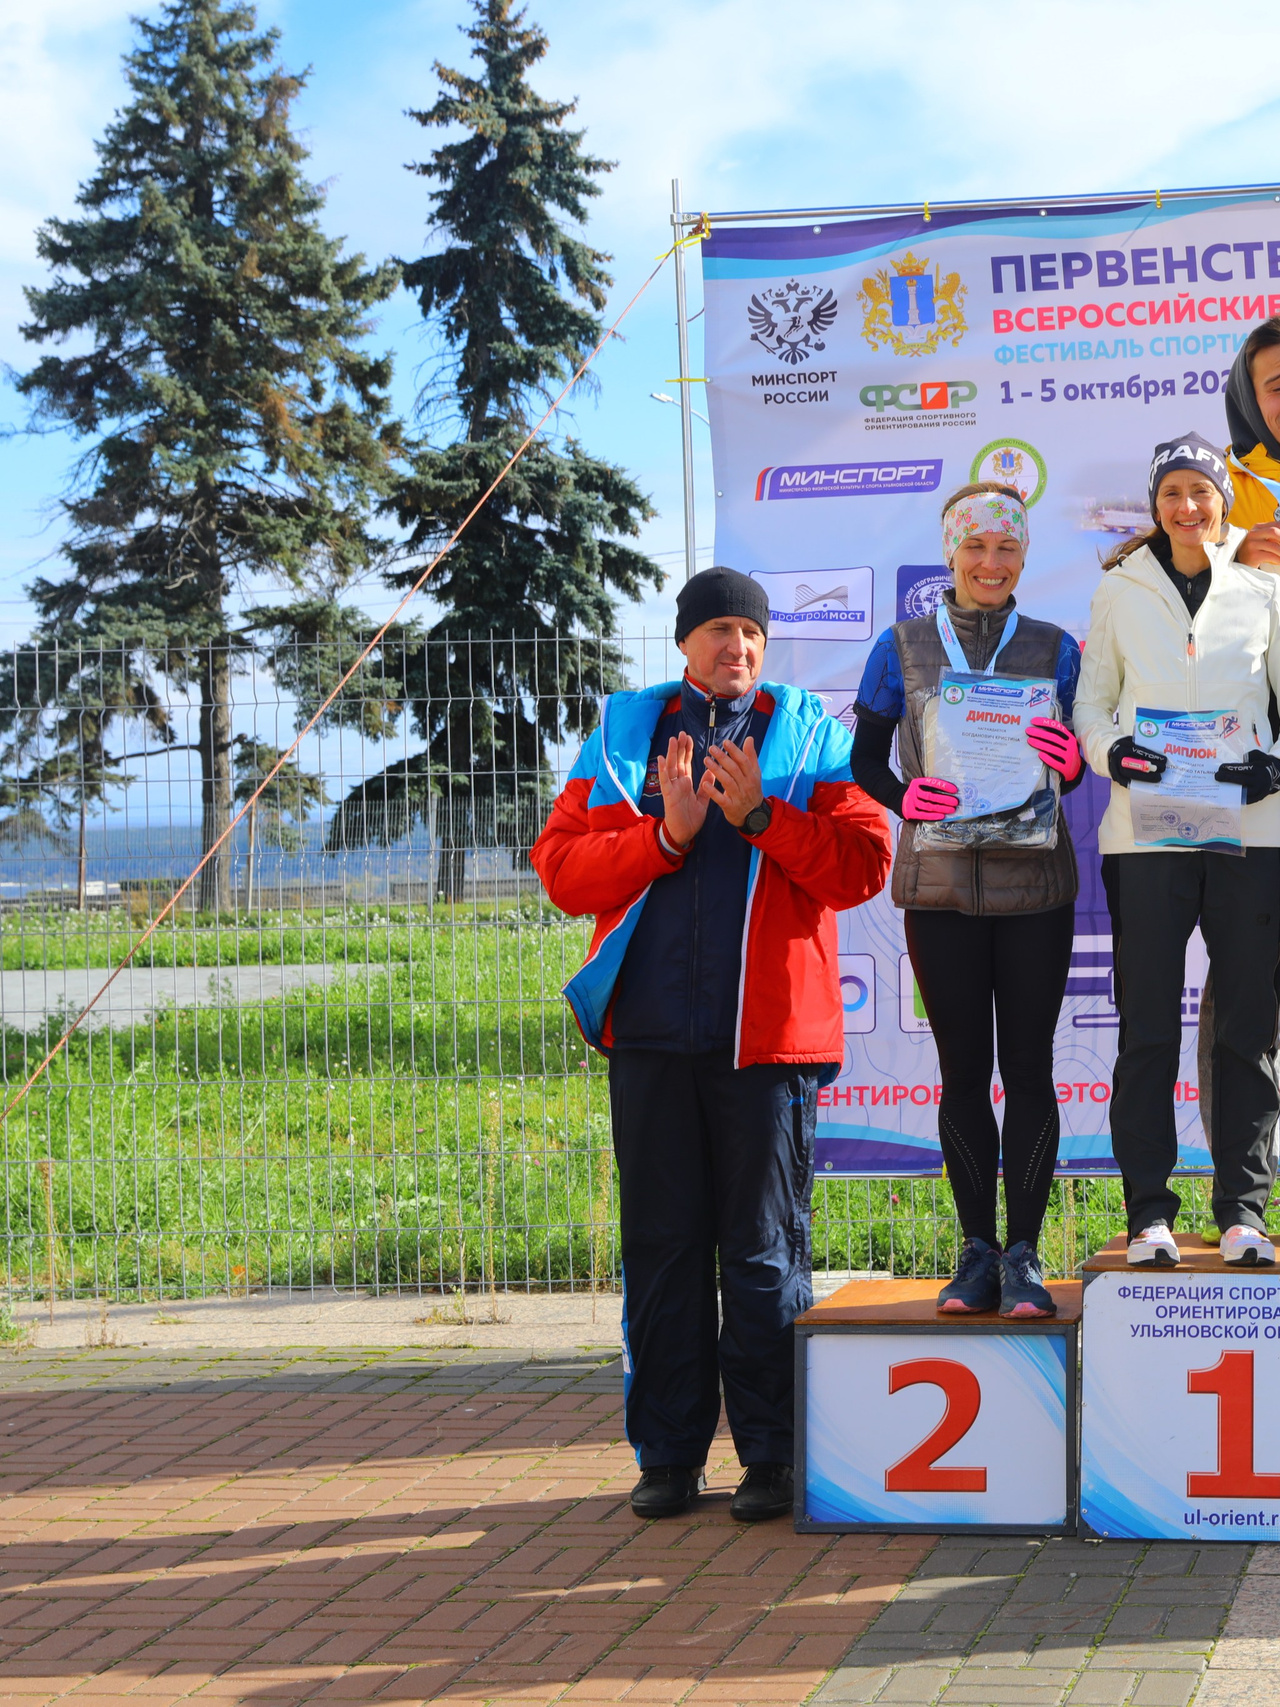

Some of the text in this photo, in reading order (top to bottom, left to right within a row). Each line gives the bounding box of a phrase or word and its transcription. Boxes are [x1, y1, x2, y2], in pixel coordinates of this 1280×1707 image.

[994, 339, 1144, 365] ФЕСТИВАЛЬ
[752, 371, 837, 386] МИНСПОРТ
[764, 390, 829, 404] РОССИИ
[1000, 381, 1014, 404] 1
[1040, 379, 1056, 402] 5
[1064, 374, 1176, 404] октября
[864, 412, 976, 424] ФЕДЕРАЦИЯ СПОРТИВНОГО
[780, 466, 934, 486] МИНСПОРТ
[1149, 445, 1224, 492] CRAFT
[978, 686, 1021, 695] МИНСПОРТ
[966, 710, 1021, 725] ДИПЛОМ
[1043, 720, 1065, 730] MOAX
[1132, 747, 1164, 760] VICTORY
[1164, 743, 1217, 759] ДИПЛОМ
[925, 778, 946, 788] MOAX
[1056, 1082, 1111, 1104] ЭТО
[1118, 1286, 1224, 1302] ФЕДЕРАЦИЯ
[1130, 1323, 1259, 1339] УЛЬЯНОВСКОЙ
[885, 1357, 987, 1492] 2
